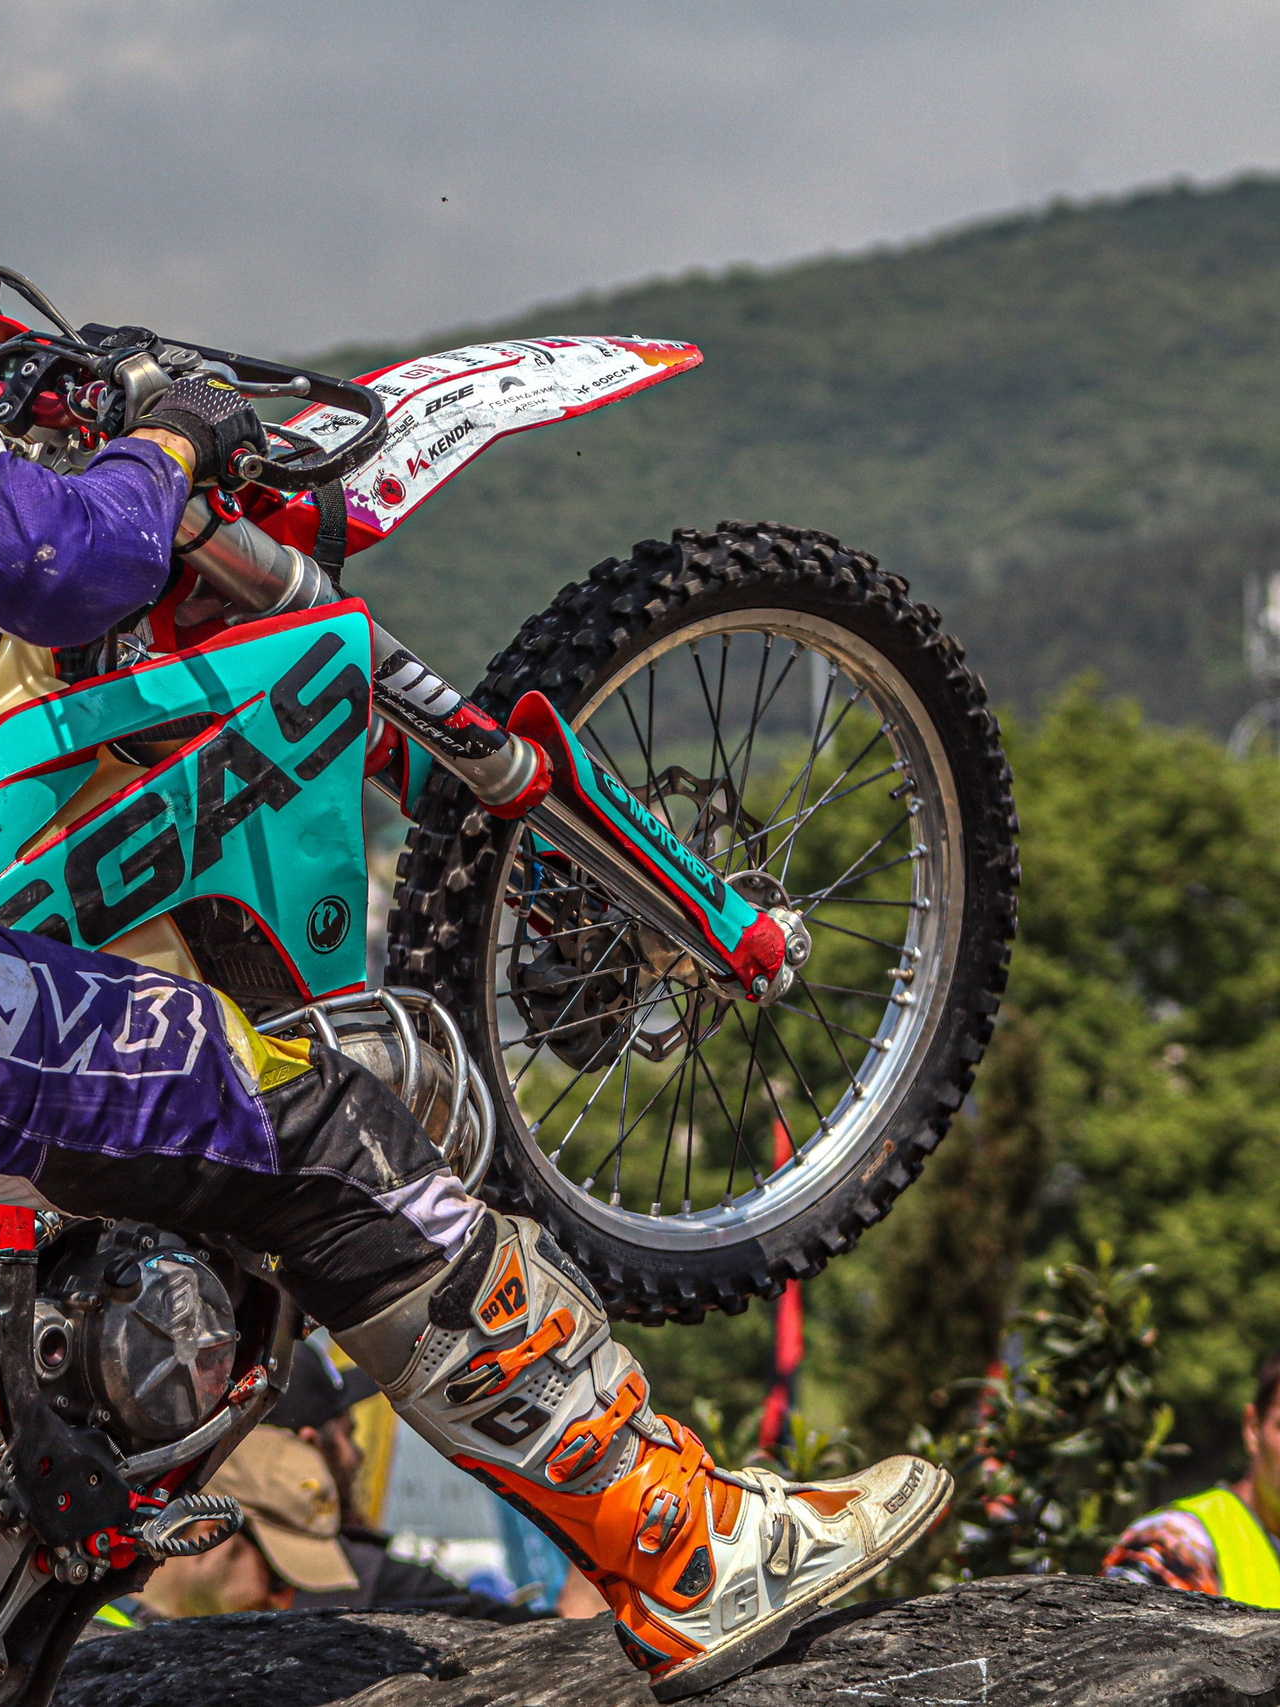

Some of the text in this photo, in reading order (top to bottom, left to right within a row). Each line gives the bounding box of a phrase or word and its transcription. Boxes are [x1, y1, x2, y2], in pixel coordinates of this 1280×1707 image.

[592, 364, 639, 388] ФОРСАЖ
[425, 384, 474, 417] BSE
[489, 385, 555, 409] ГЕЛЕНДЖИК
[514, 398, 548, 413] АРЕНА
[428, 419, 475, 461] KENDA
[628, 802, 719, 897] MOTOREX
